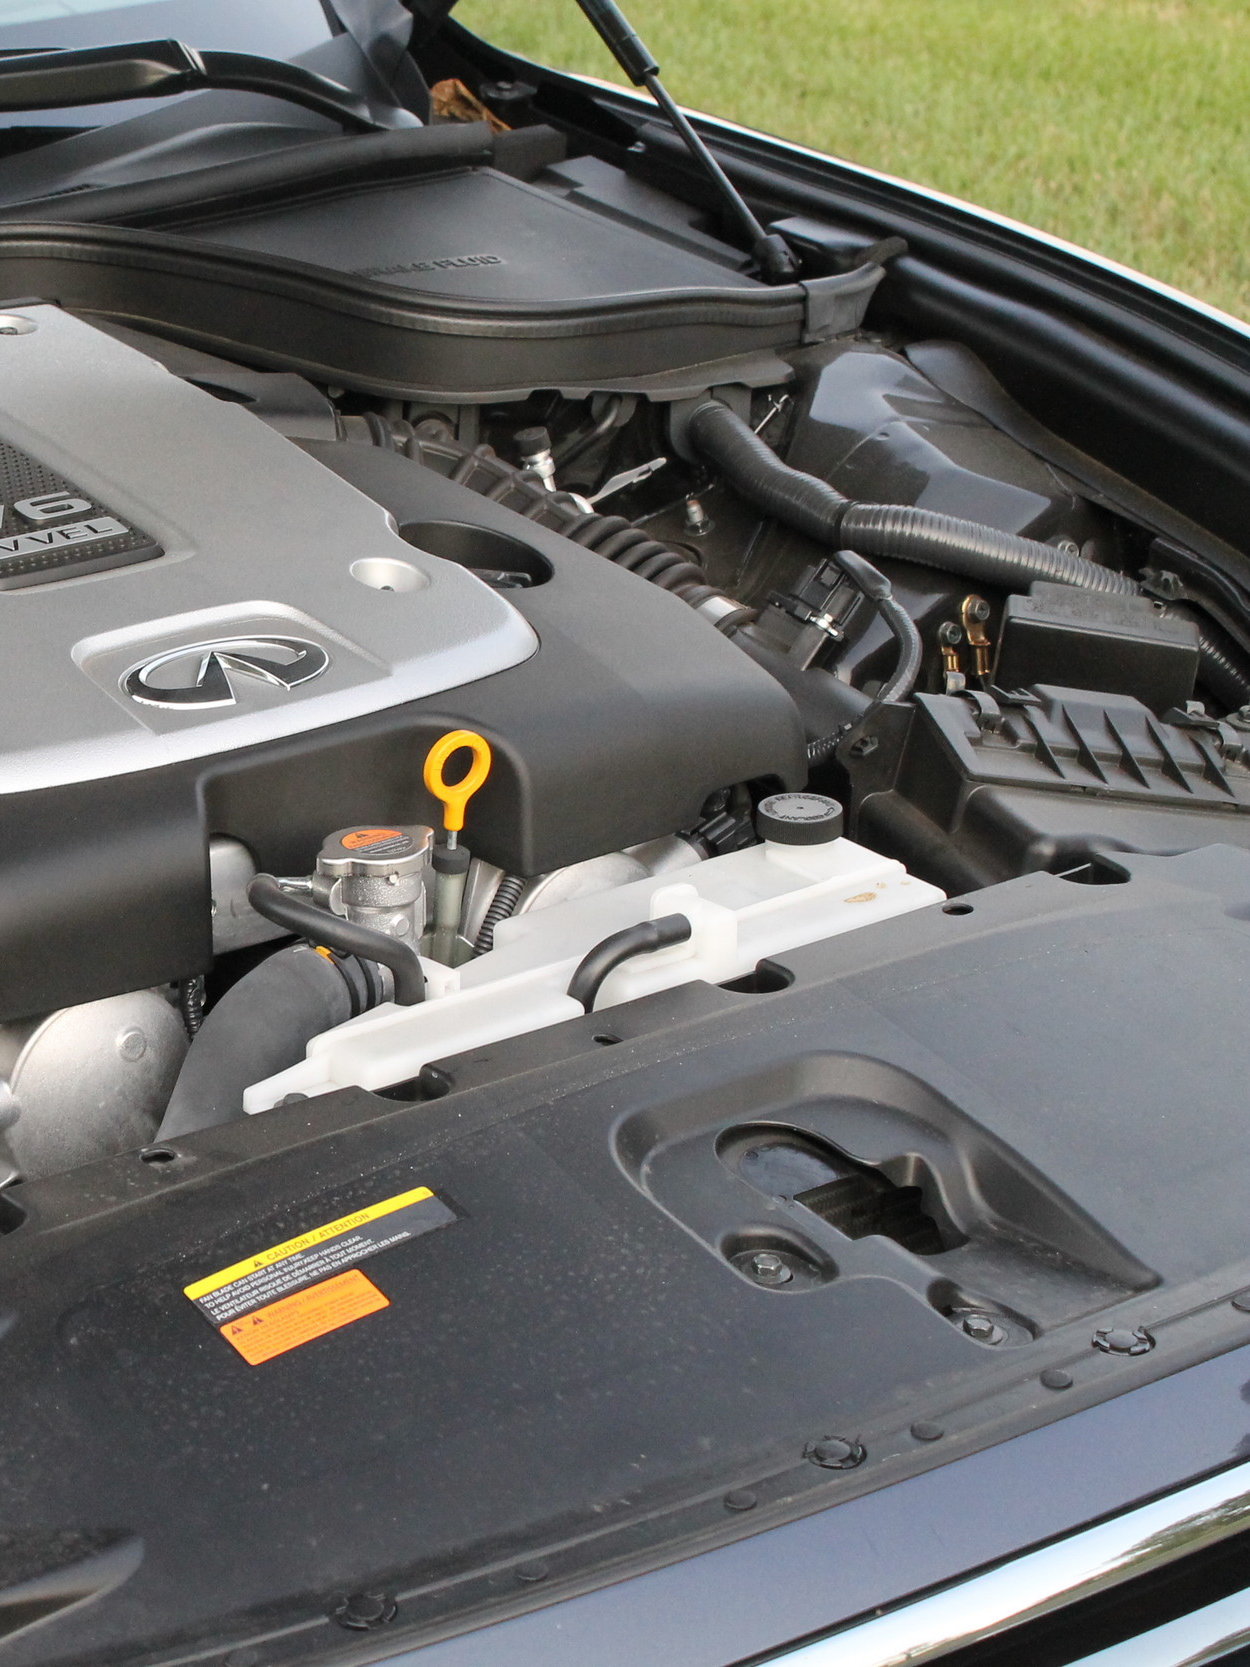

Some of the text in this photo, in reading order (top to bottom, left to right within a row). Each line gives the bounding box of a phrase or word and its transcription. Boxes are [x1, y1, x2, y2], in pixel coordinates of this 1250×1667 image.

[433, 254, 502, 269] FLUID
[266, 1238, 309, 1260] CAUTION
[318, 1213, 369, 1238] ATTENTION
[318, 1264, 332, 1272] PAS
[377, 1239, 390, 1247] LES
[199, 1294, 213, 1303] FAN
[212, 1284, 233, 1297] BLADE
[232, 1278, 248, 1287] CAN
[247, 1269, 266, 1280] START
[275, 1259, 287, 1268] ANY
[210, 1307, 220, 1315] LE
